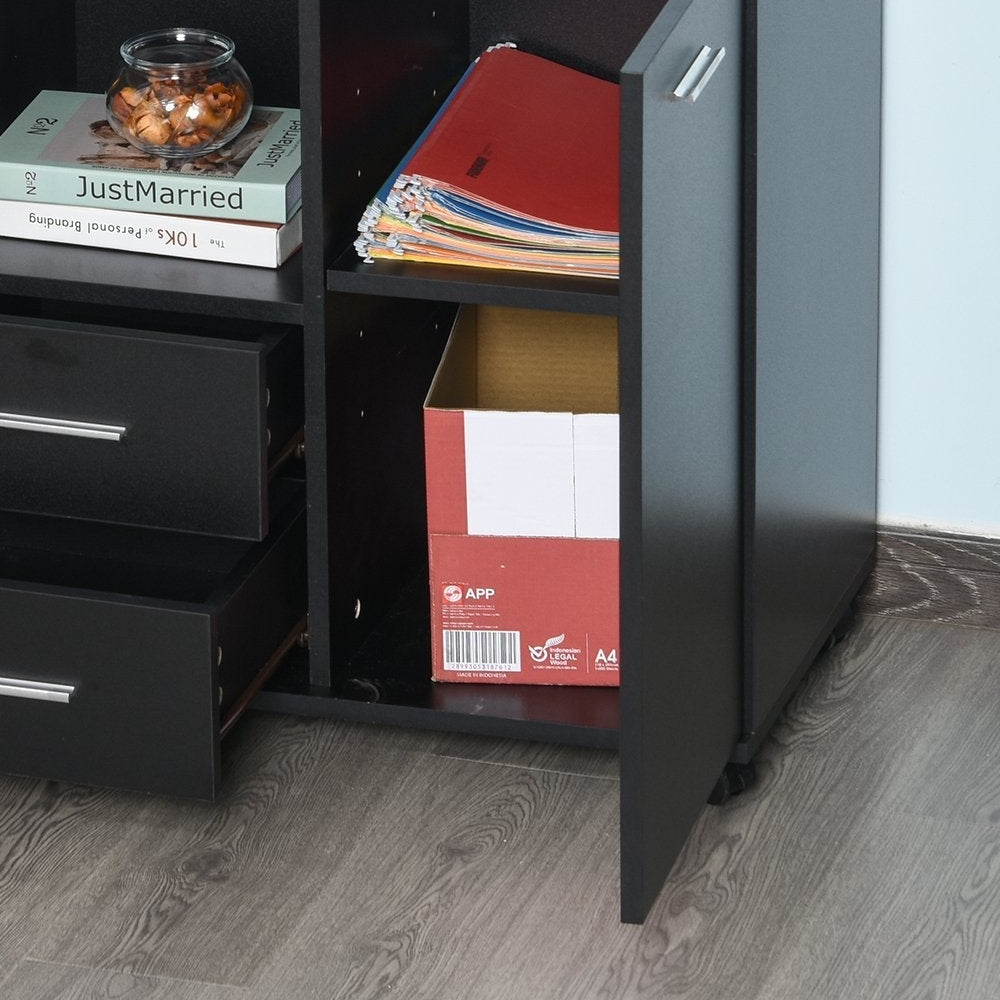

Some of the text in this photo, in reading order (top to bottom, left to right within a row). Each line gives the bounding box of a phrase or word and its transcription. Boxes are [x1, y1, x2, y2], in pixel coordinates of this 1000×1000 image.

[76, 175, 243, 210] JustMarried
[29, 212, 81, 233] Branding
[87, 222, 142, 239] Personal
[145, 227, 153, 235] of
[209, 239, 225, 249] The
[465, 588, 495, 600] APP
[549, 653, 577, 661] LEGAL
[595, 648, 617, 663] A4
